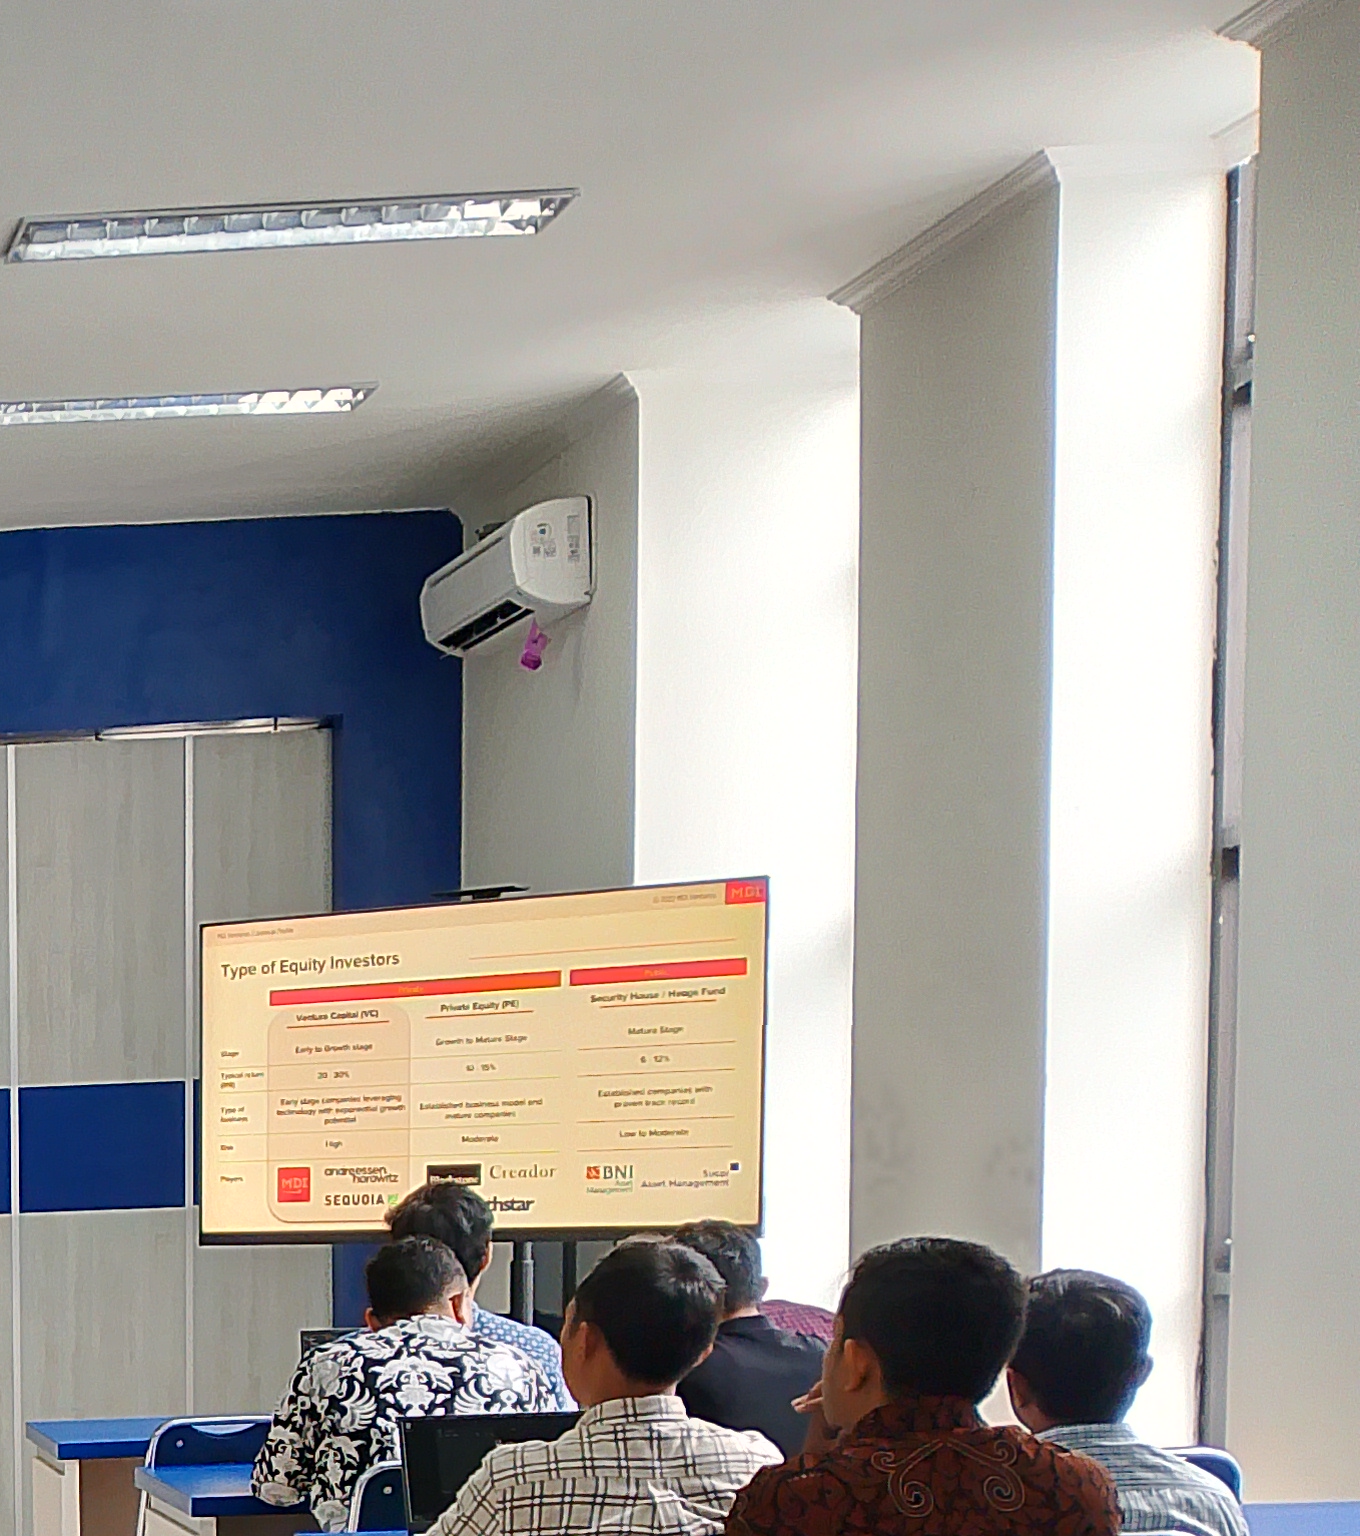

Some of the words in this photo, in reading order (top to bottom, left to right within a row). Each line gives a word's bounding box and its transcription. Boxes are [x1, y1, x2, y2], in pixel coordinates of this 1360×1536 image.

[221, 964, 257, 980] Type
[261, 961, 277, 974] of
[280, 958, 326, 976] Equity
[330, 953, 400, 969] Investors
[590, 991, 627, 1002] Security
[701, 987, 726, 996] Fund
[440, 1003, 470, 1012] Private
[472, 1002, 499, 1011] Equity
[330, 1011, 358, 1020] Capital
[489, 1163, 557, 1179] Creador
[603, 1165, 634, 1179] BNI
[281, 1177, 308, 1189] MDI
[324, 1194, 385, 1206] SEQUOIA
